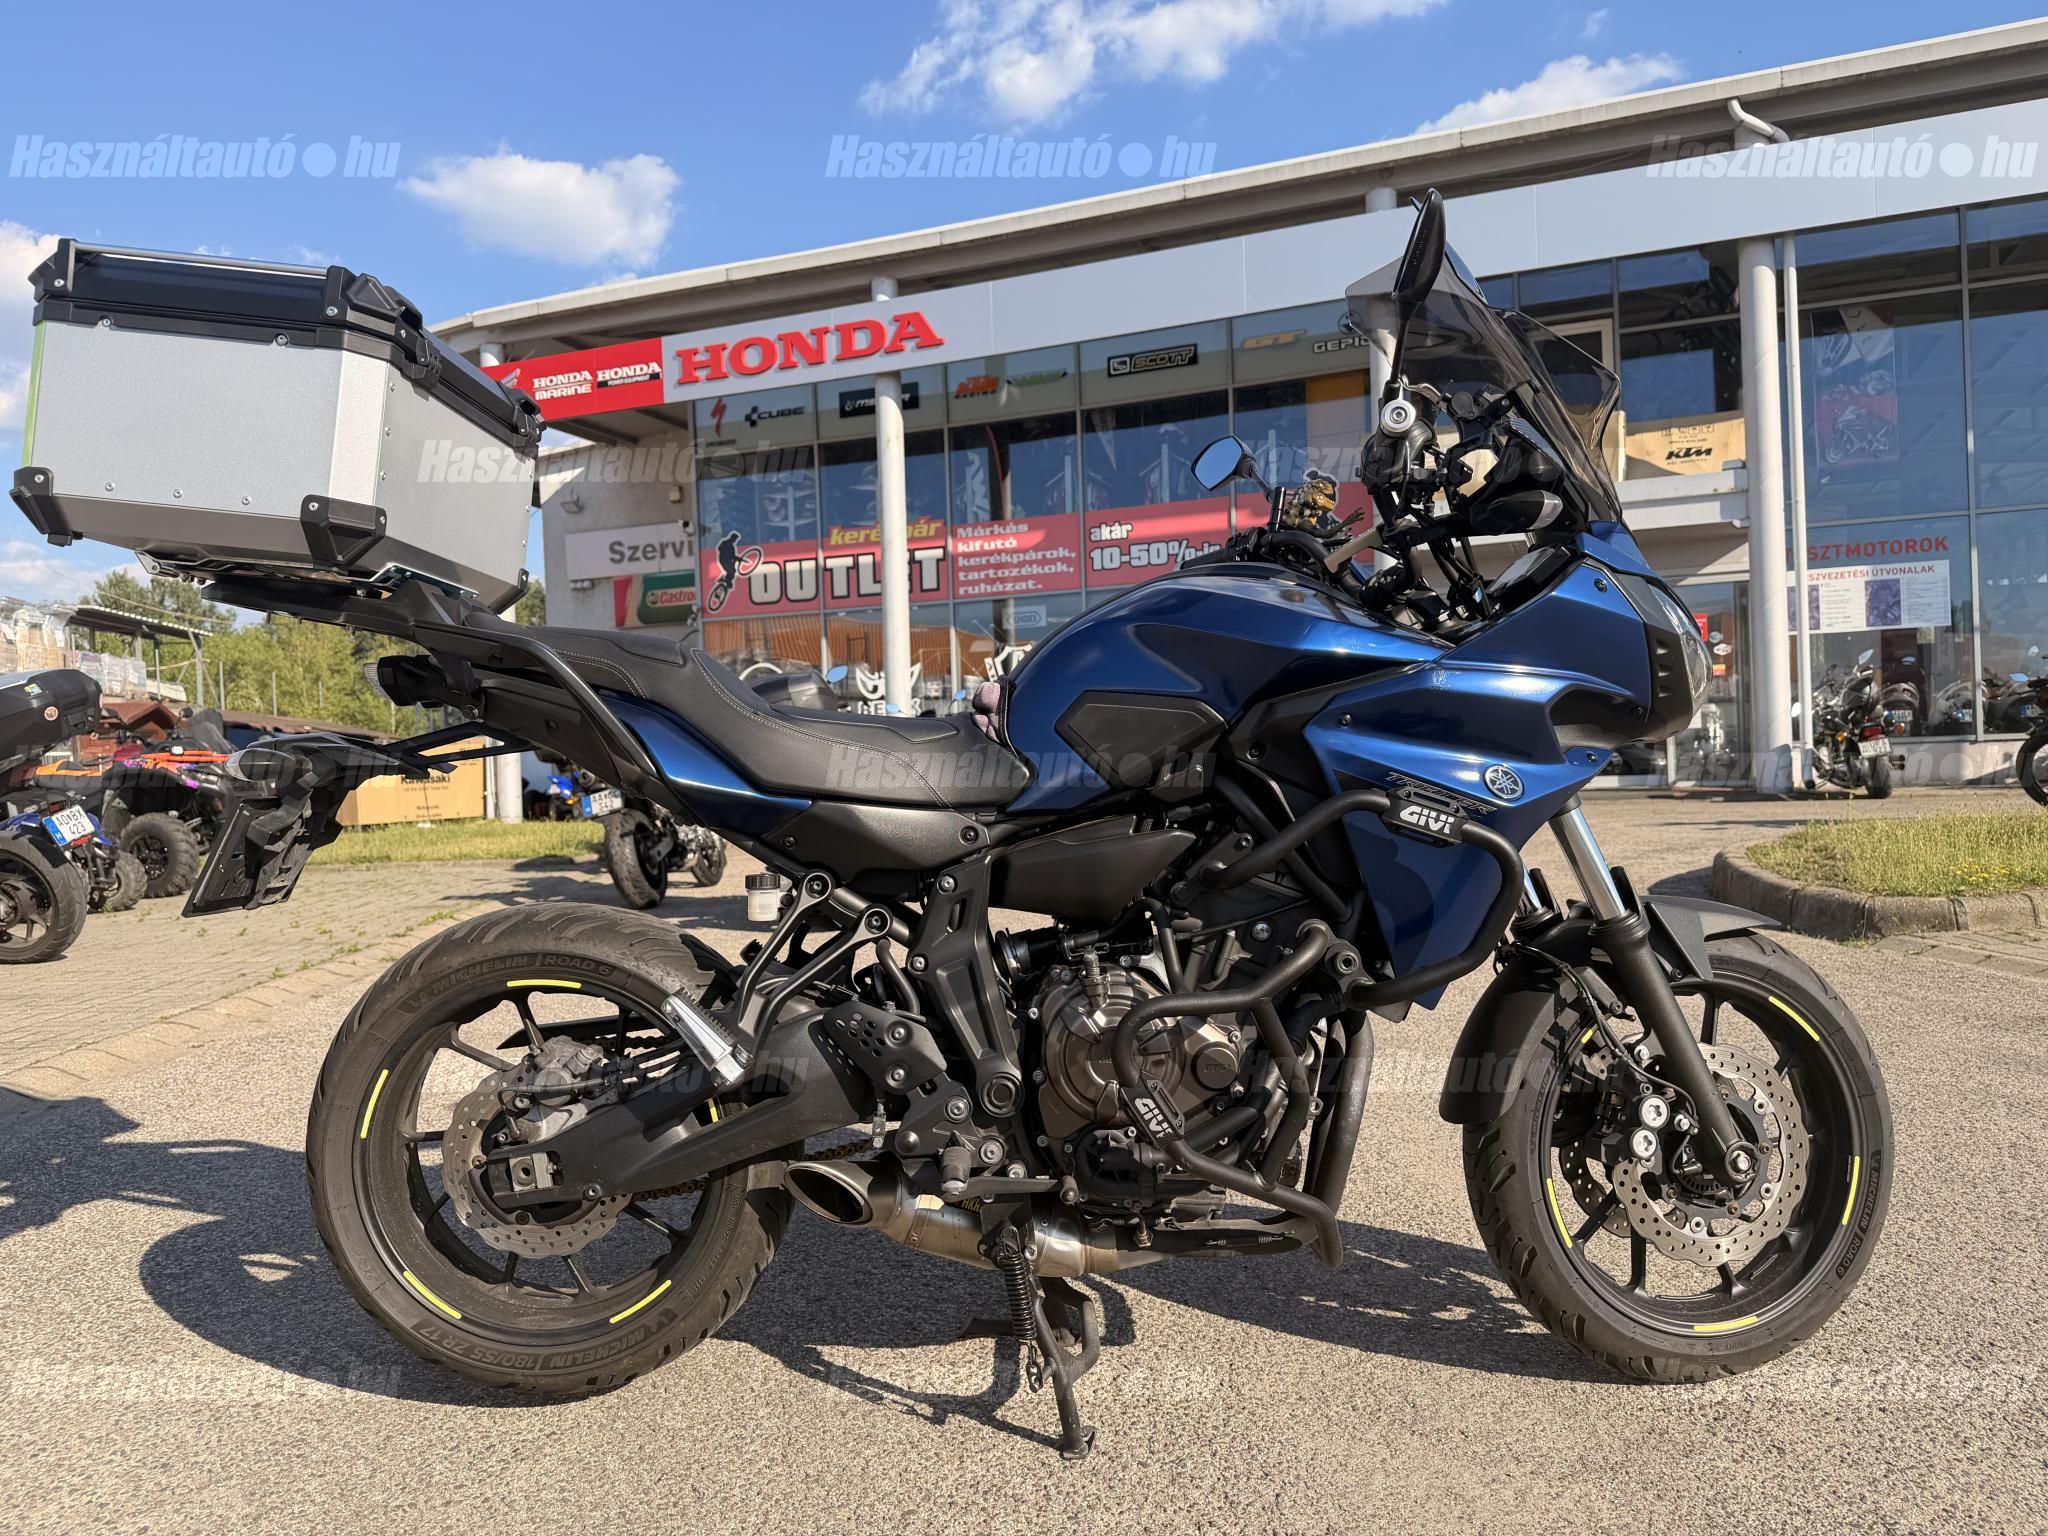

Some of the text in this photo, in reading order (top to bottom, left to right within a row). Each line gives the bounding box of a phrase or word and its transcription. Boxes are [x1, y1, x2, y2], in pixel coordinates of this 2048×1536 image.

[676, 311, 946, 386] HONDA
[1132, 347, 1195, 371] SCOTT
[533, 370, 594, 389] HONDA
[597, 361, 662, 382] HONDA
[535, 383, 593, 400] MARINE
[757, 406, 806, 420] CUBE
[1665, 447, 1713, 461] KTM
[957, 522, 1029, 539] Márkás
[1090, 521, 1133, 542] akár
[957, 537, 1018, 553] kifutó
[958, 545, 1077, 567] kerékpárok,
[749, 546, 945, 605] OUTLT
[958, 562, 1074, 581] tartozékok,
[958, 580, 1043, 596] ruházat.
[69, 821, 86, 836] 423
[1400, 805, 1455, 834] GIVI
[431, 954, 529, 993] MICHELIN
[544, 955, 595, 971] ROAD
[1134, 1097, 1173, 1138] GIVI
[1861, 1169, 1880, 1230] MICHELIN
[1843, 1238, 1861, 1266] ROAD
[420, 1326, 646, 1369] MICHELIN 180/55 ZR 17
